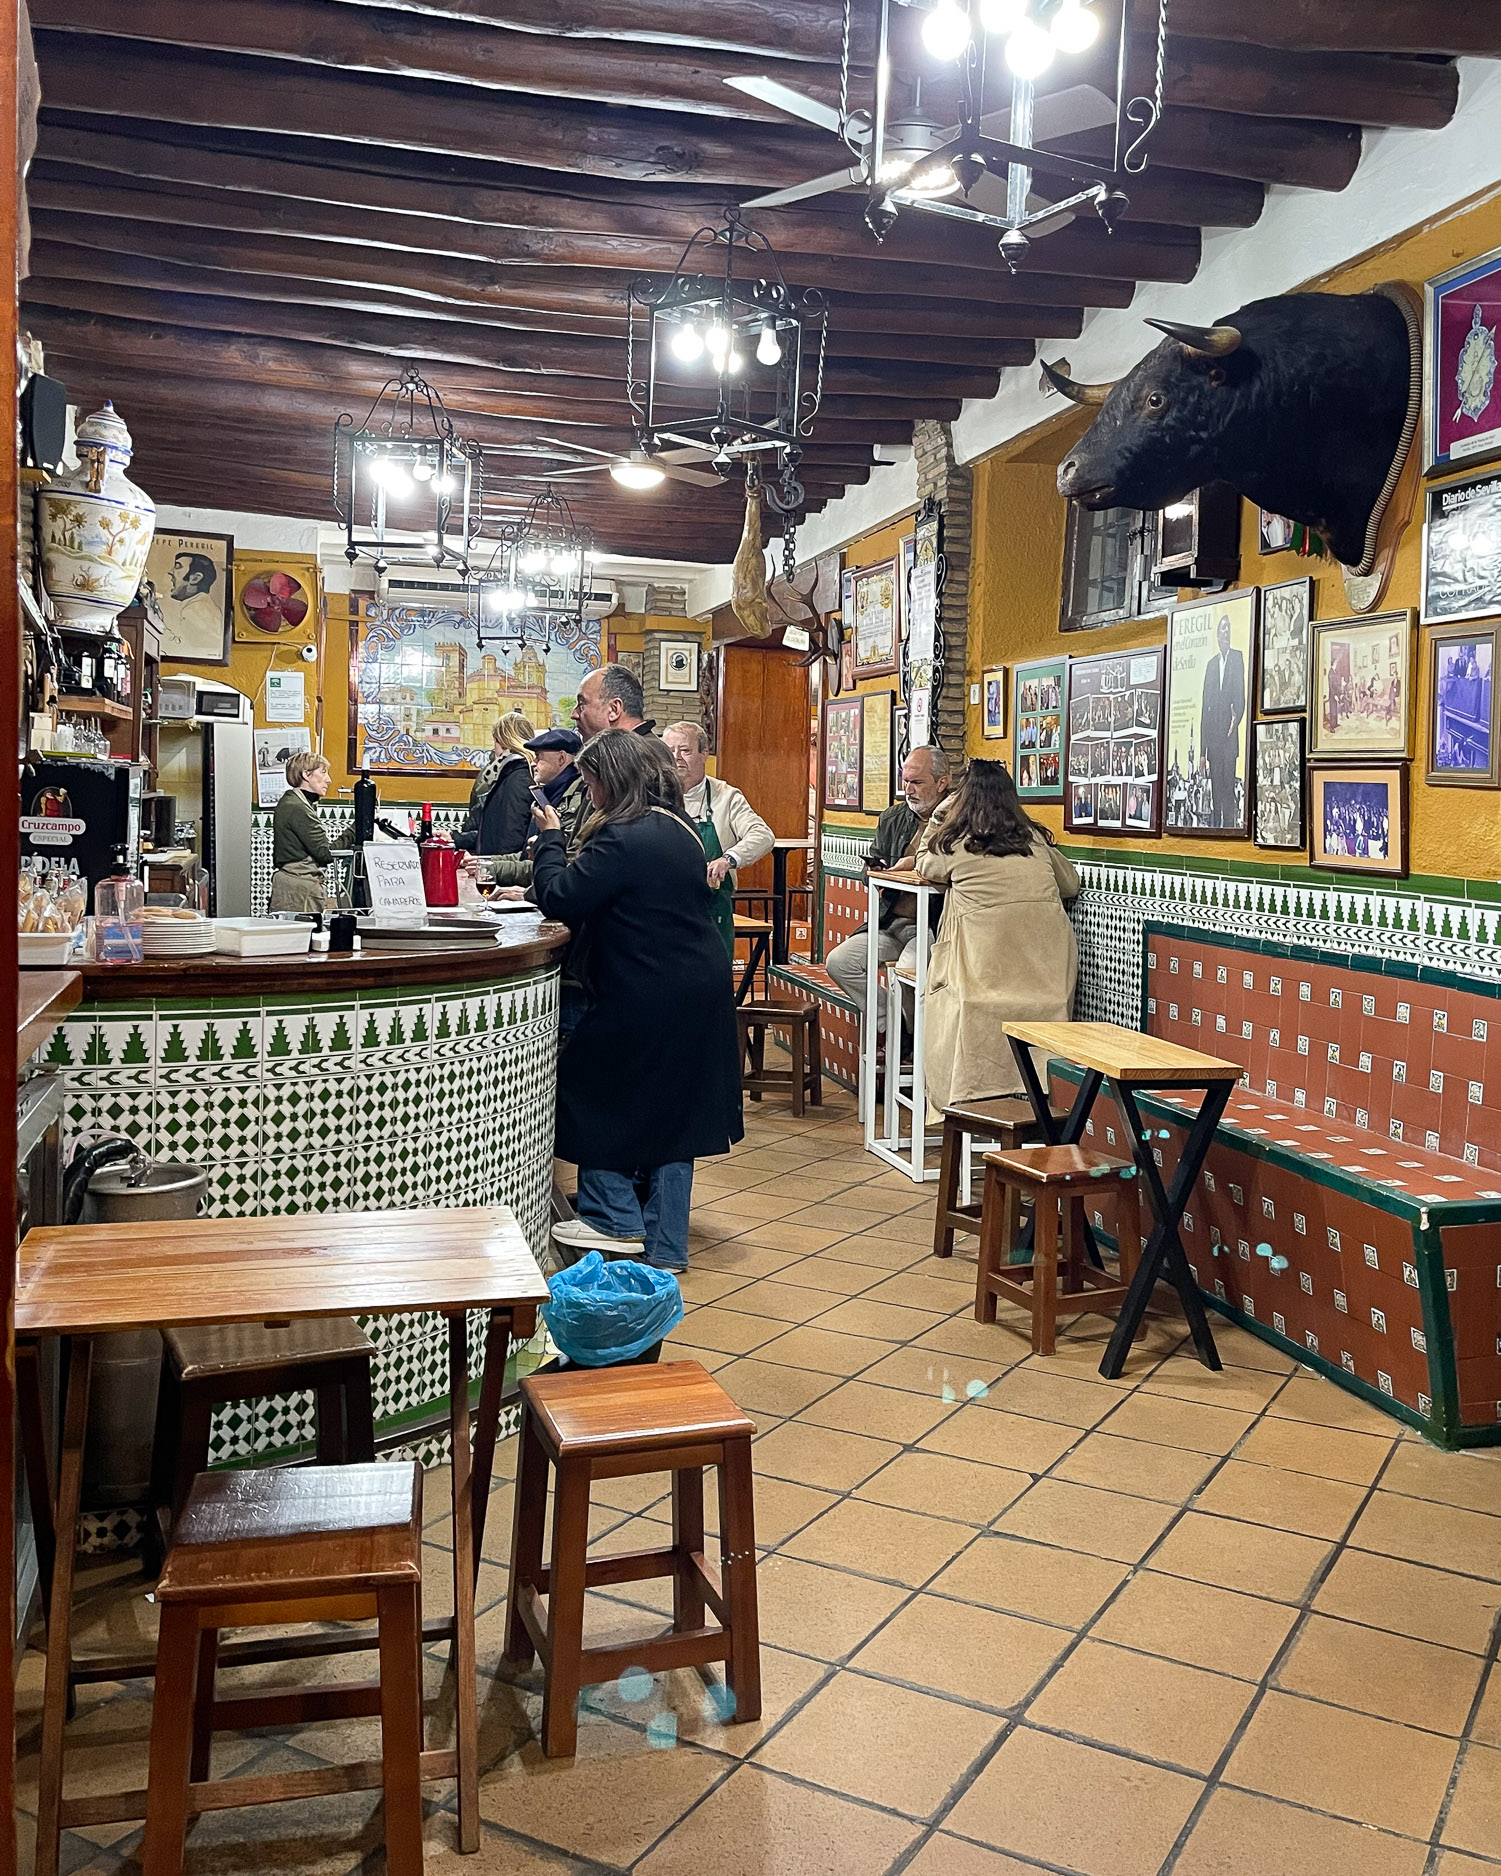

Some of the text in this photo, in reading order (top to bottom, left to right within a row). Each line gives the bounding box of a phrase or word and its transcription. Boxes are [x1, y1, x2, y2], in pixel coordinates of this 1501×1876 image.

[1442, 490, 1466, 506] Diario
[1466, 487, 1476, 500] de
[178, 538, 214, 550] PEREGIL
[1173, 613, 1212, 636] PEREGIL
[21, 820, 81, 832] Cruzcampo
[33, 833, 68, 843] ESPECIAL
[376, 874, 406, 888] PARA
